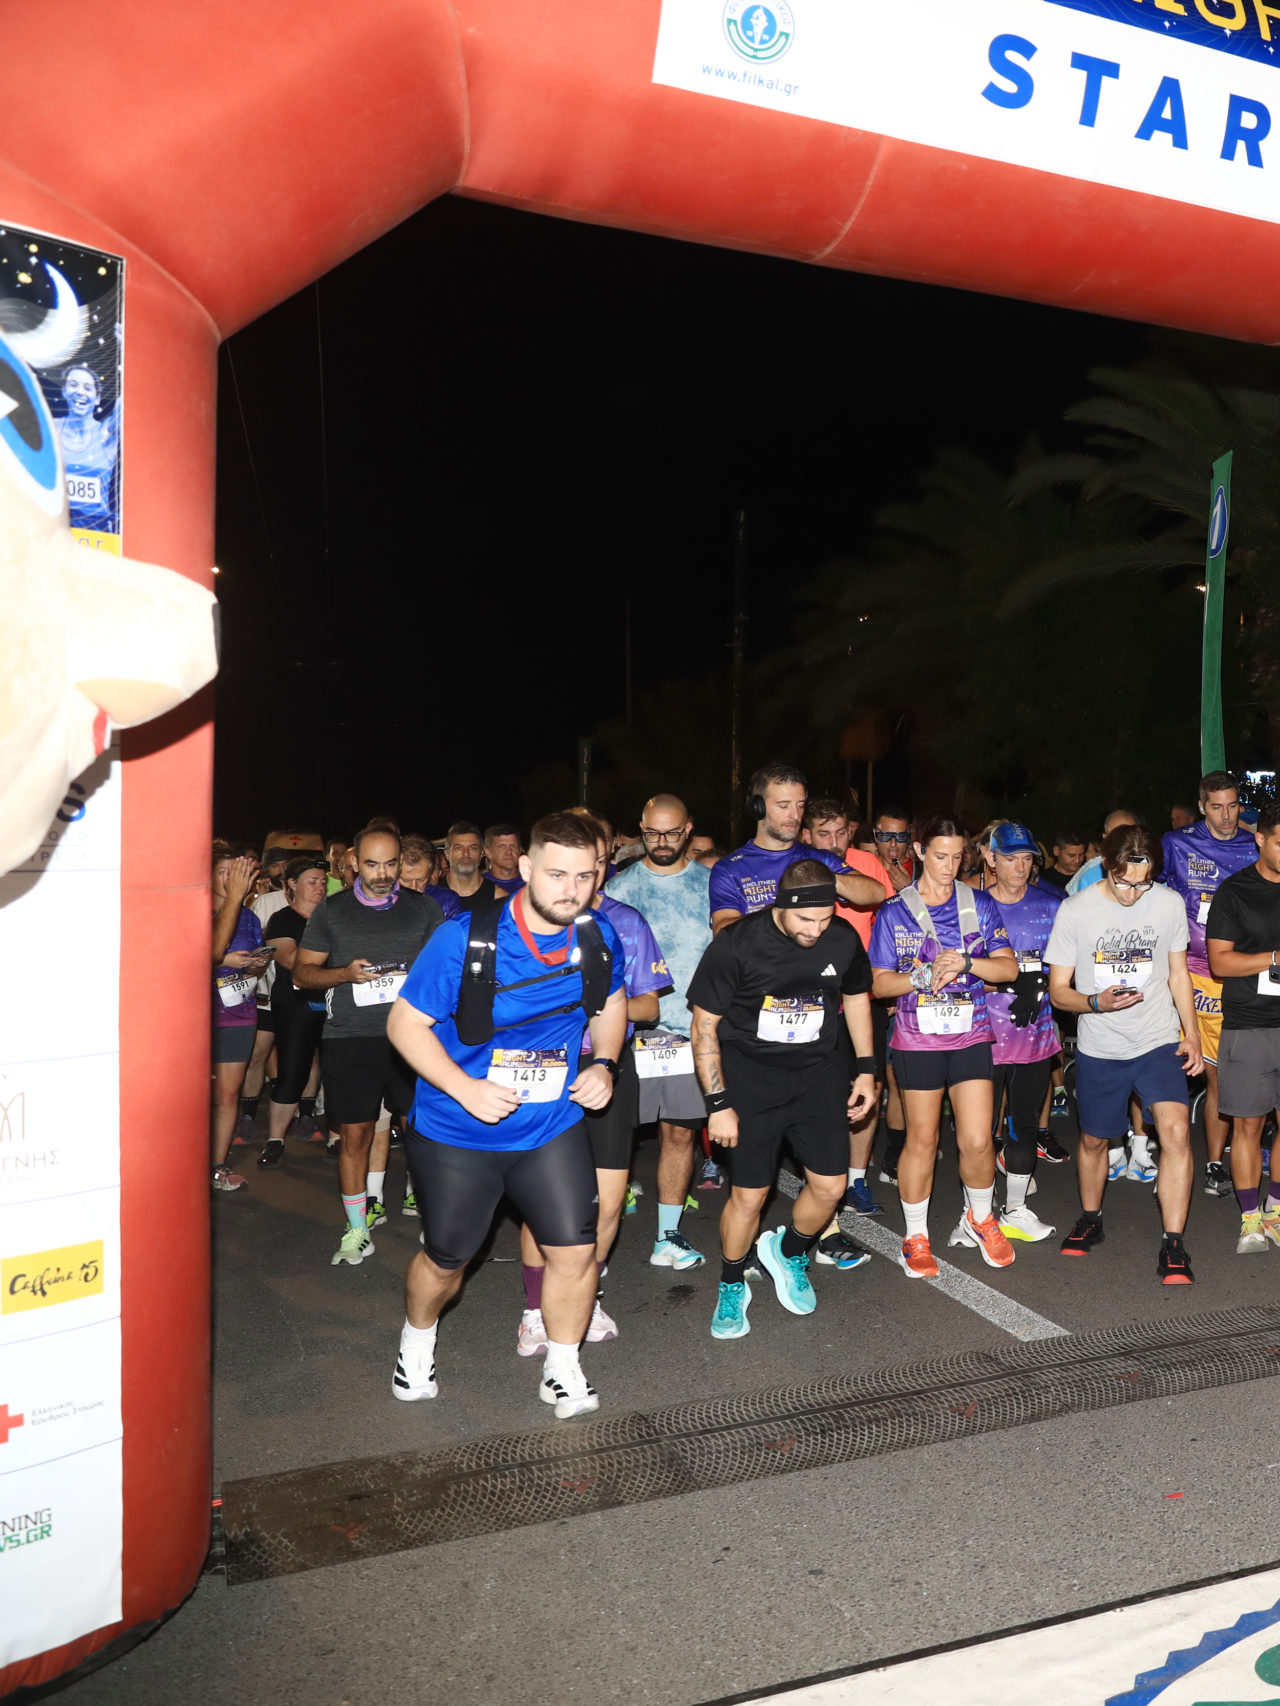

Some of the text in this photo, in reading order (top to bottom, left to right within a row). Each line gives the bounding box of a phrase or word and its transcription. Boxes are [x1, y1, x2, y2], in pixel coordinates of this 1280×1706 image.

[701, 64, 800, 96] www.filkal.gr
[1188, 862, 1214, 872] NIGHT
[743, 884, 777, 896] NIGHT
[746, 893, 769, 903] RUN
[895, 938, 922, 947] NIGH
[1112, 964, 1138, 974] 1424
[232, 980, 250, 992] 1591
[369, 977, 394, 989] 1359
[1194, 988, 1223, 1013] AKE
[934, 1006, 960, 1018] 1492
[780, 1013, 809, 1025] 1477
[652, 1049, 678, 1061] 1409
[513, 1069, 547, 1082] 1413
[2, 1150, 62, 1172] ΓΝΗΣ
